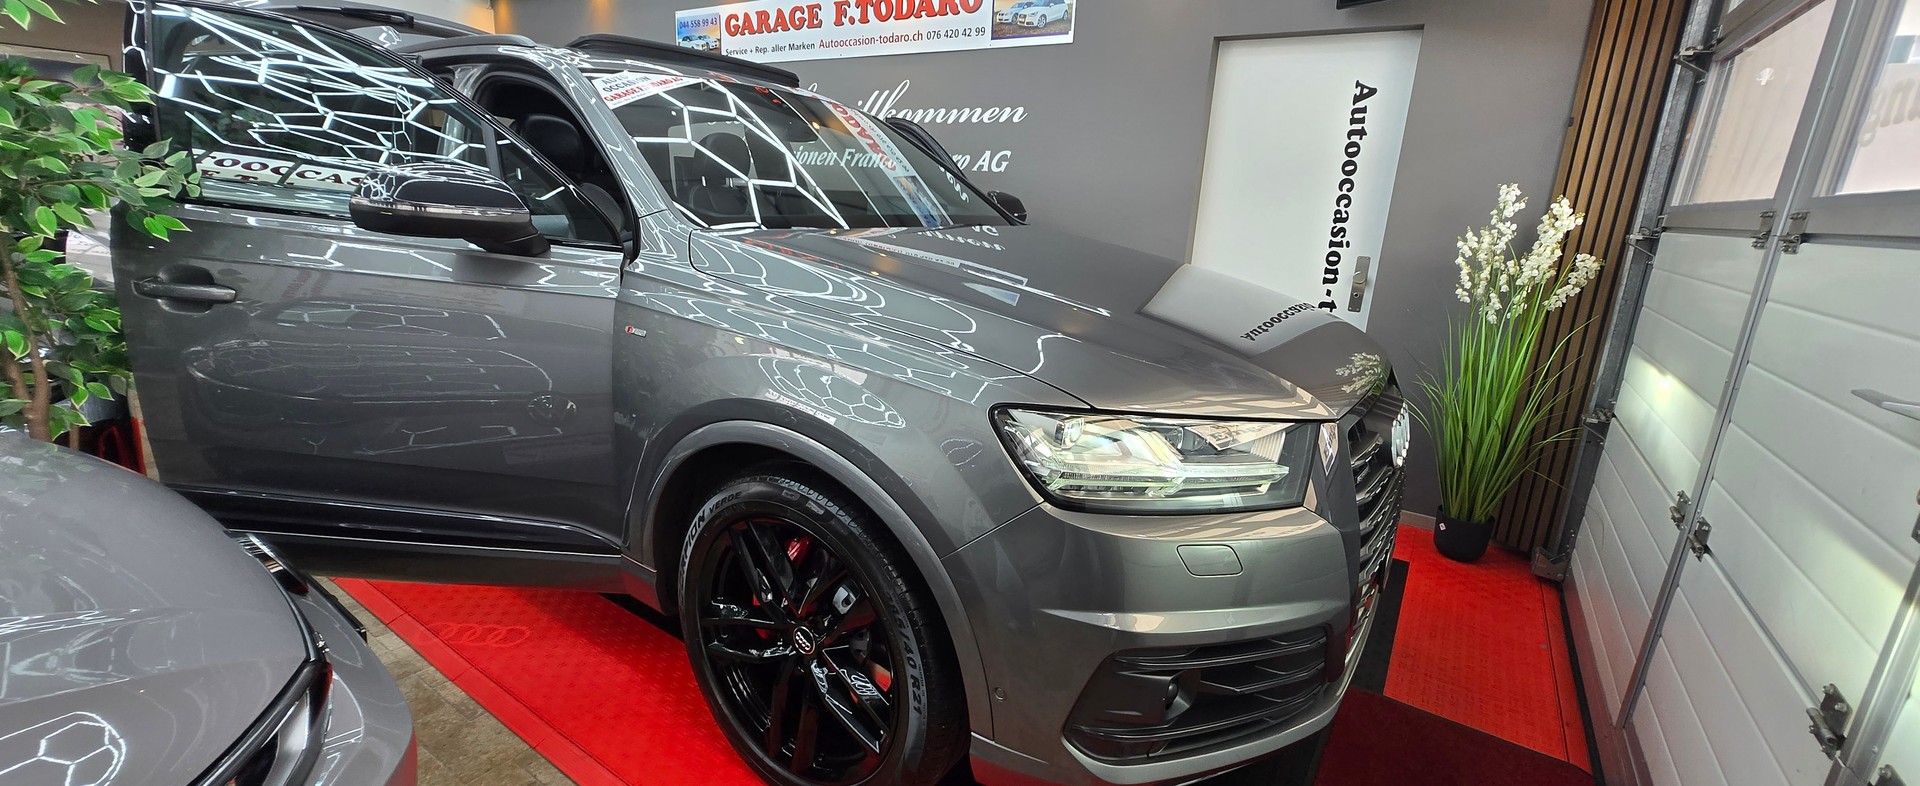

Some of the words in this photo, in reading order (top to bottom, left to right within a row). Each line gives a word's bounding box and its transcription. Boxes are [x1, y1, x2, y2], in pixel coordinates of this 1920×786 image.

[679, 20, 690, 29] 044
[690, 19, 701, 28] 558
[701, 18, 709, 27] 99
[710, 17, 718, 26] 43
[725, 3, 823, 37] GARAGE
[725, 47, 748, 56] Service
[755, 46, 768, 55] Rep.
[771, 44, 787, 53] aller
[788, 43, 816, 52] Marken
[818, 30, 924, 49] Autooccasion-todaro.ch
[926, 30, 942, 40] 076
[944, 29, 960, 39] 420
[961, 28, 972, 37] 42
[975, 27, 986, 36] 99
[972, 150, 1012, 172] AG
[709, 492, 742, 514] VERDE
[910, 674, 923, 715] R21
